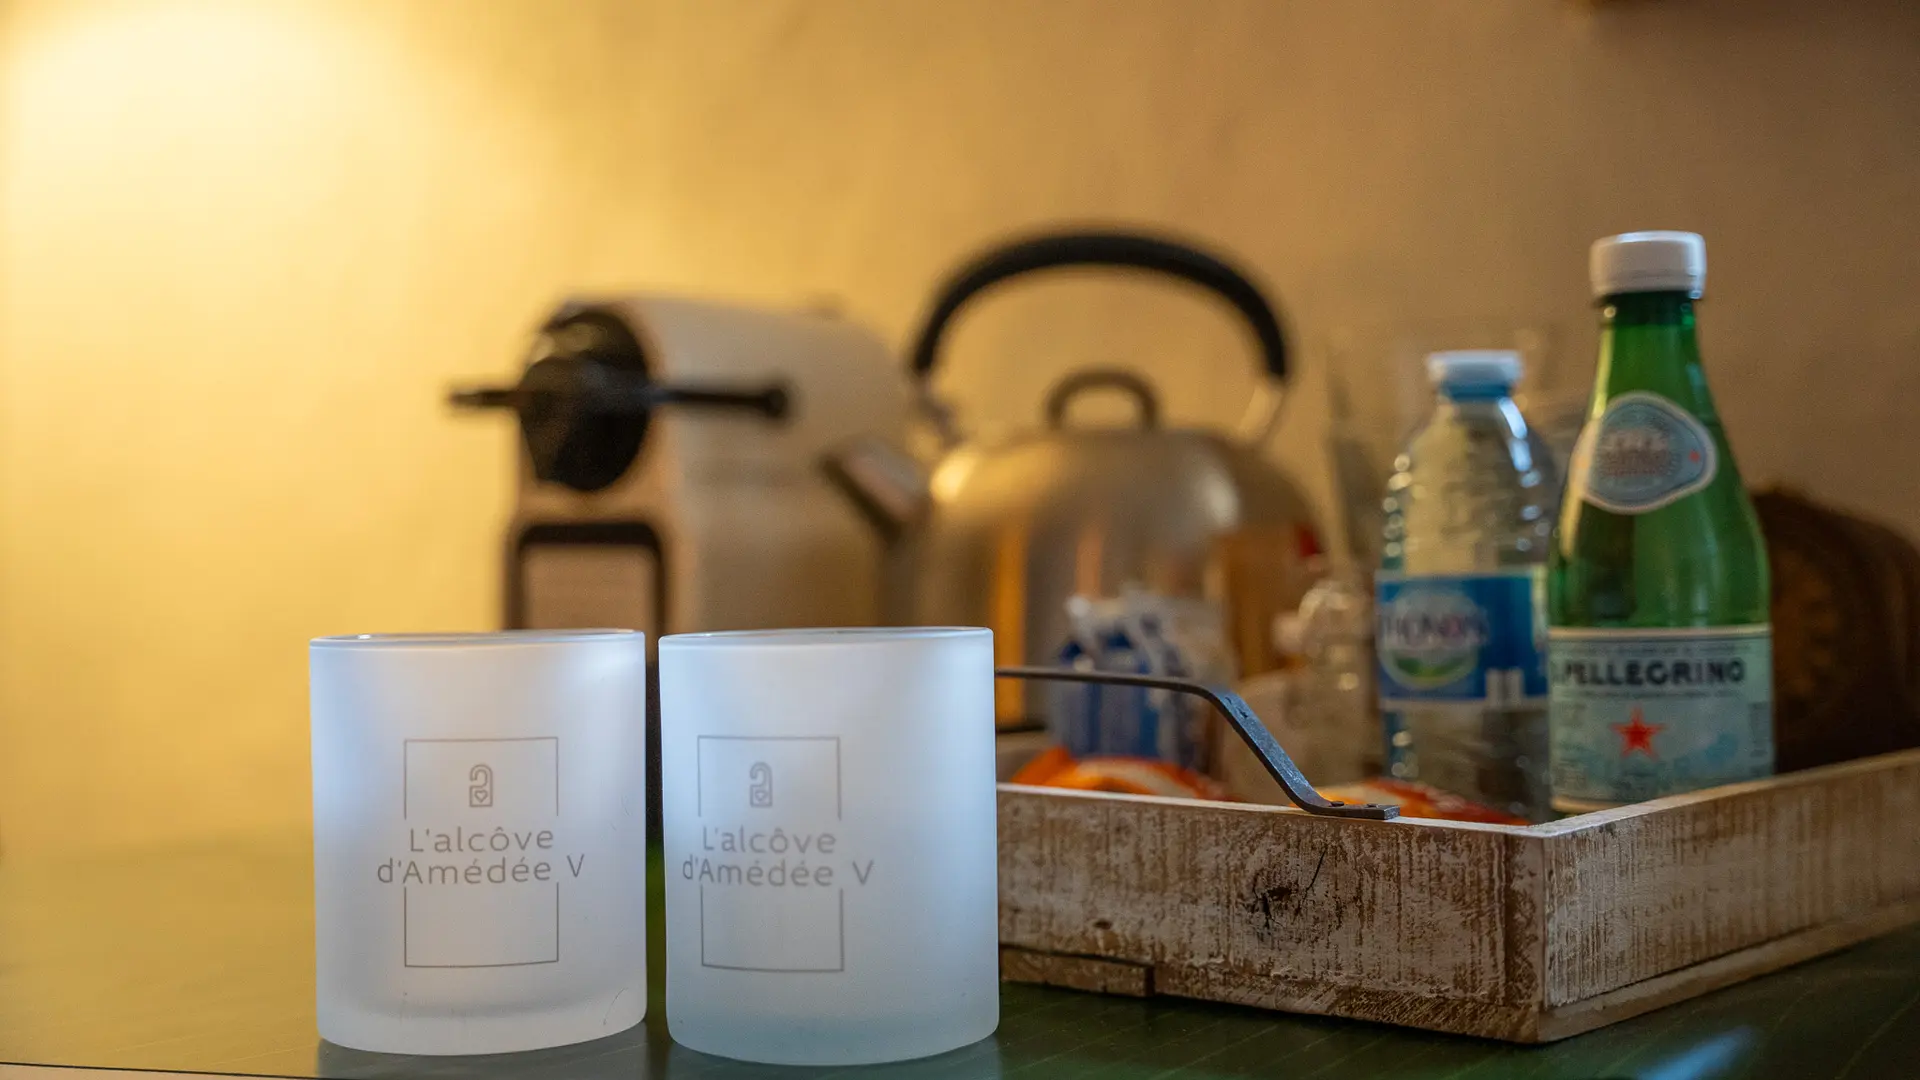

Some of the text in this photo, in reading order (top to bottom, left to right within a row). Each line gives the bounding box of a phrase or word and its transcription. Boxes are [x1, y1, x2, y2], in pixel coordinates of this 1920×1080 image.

[409, 826, 553, 852] L'alcôve
[703, 825, 836, 854] L'alcôve
[377, 853, 585, 884] d'Amédée V
[682, 854, 874, 887] d'Amédée V
